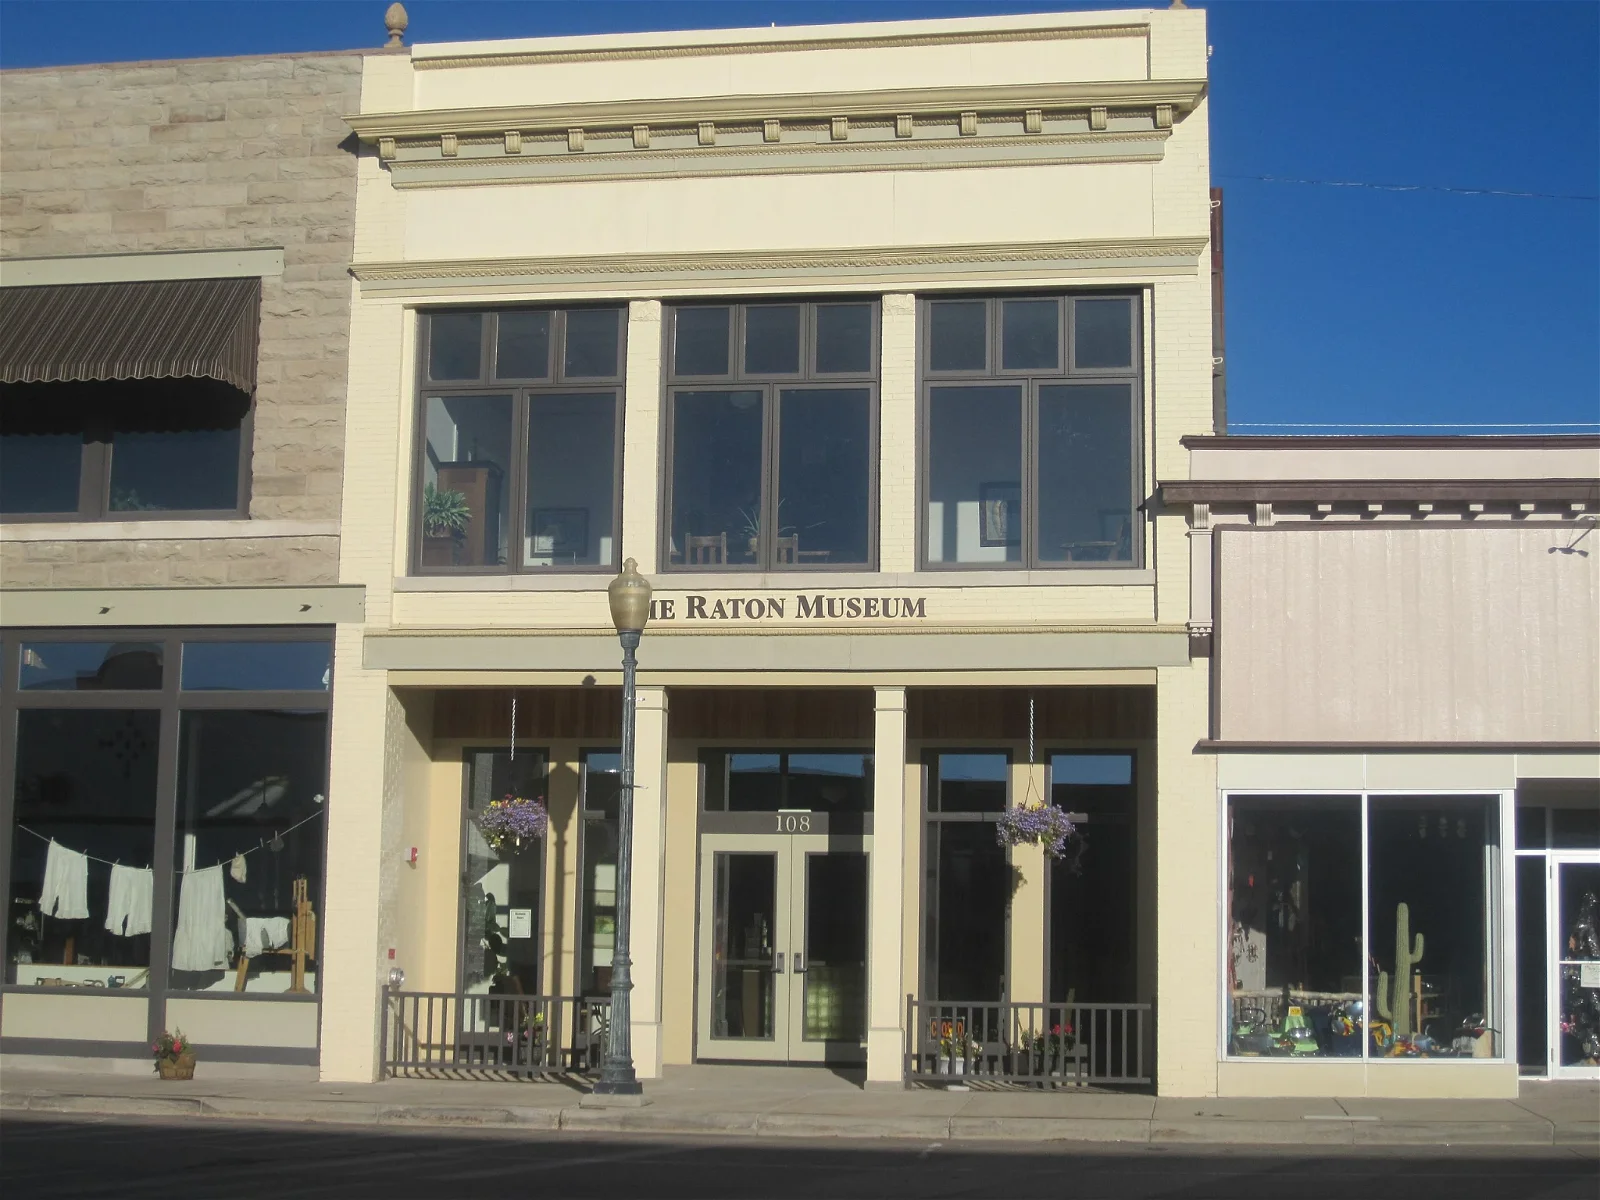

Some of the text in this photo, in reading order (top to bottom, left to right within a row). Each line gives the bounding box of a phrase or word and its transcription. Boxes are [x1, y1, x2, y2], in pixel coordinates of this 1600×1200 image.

[685, 595, 786, 620] RATON
[795, 594, 927, 619] MUSEUM
[776, 815, 810, 833] 108
[931, 1021, 963, 1038] COSD
